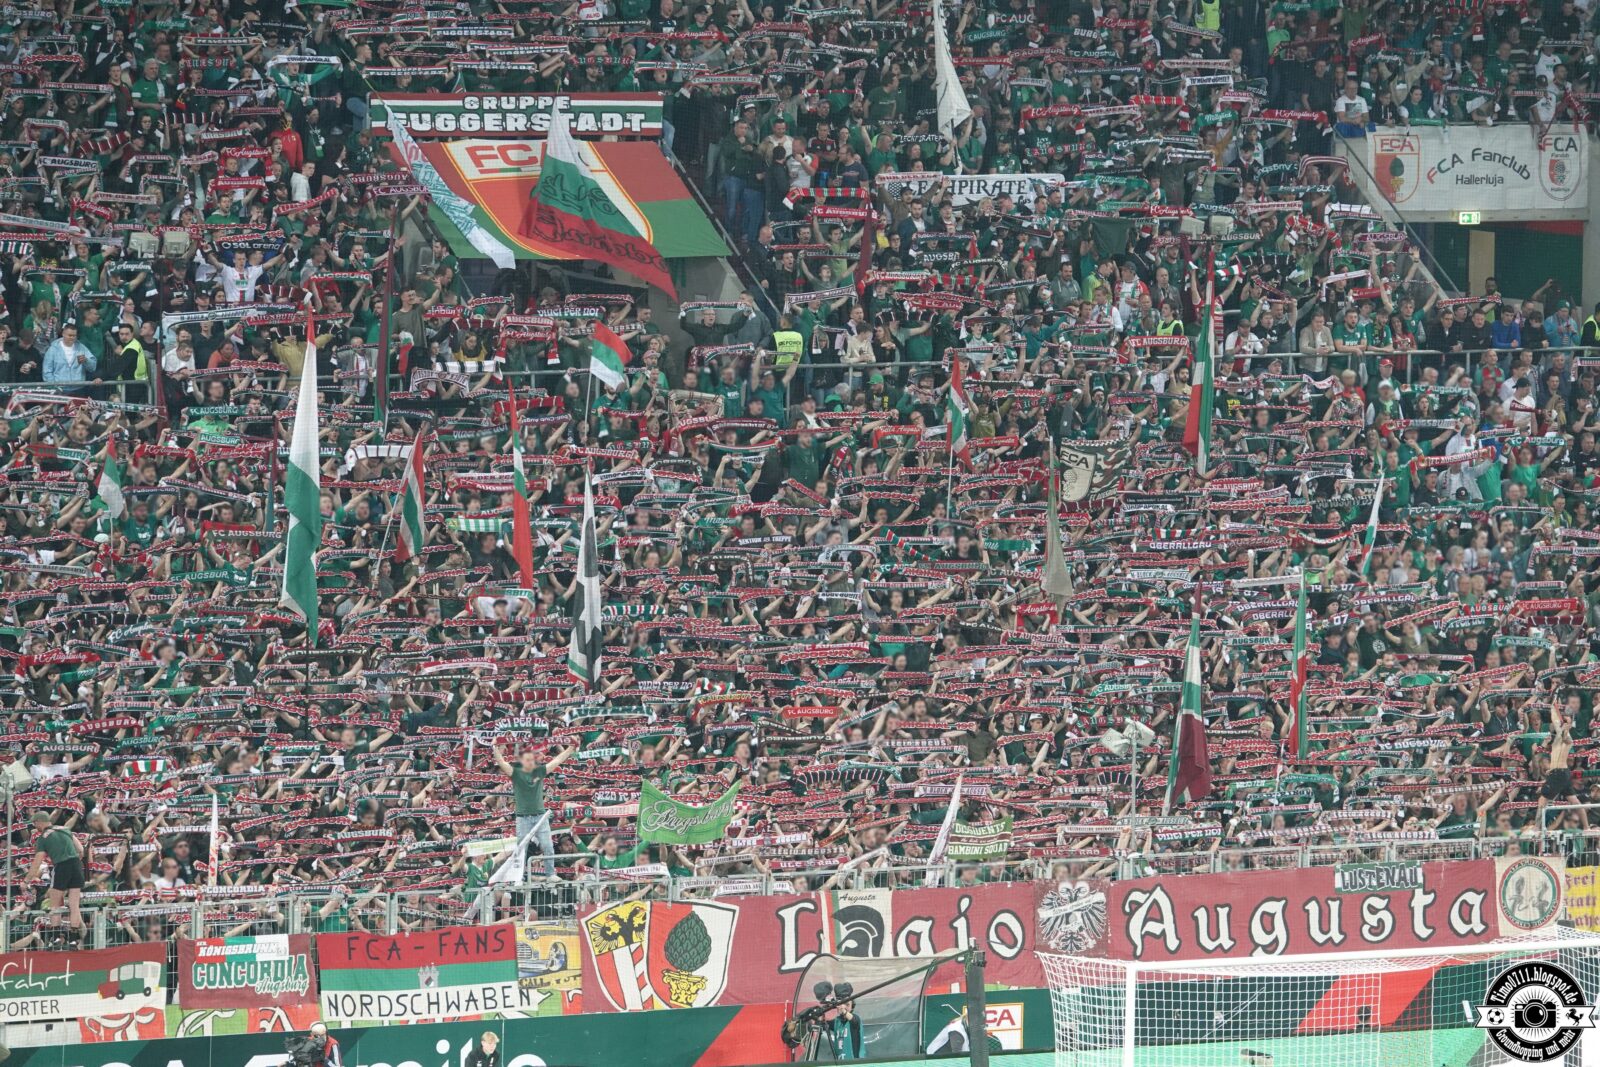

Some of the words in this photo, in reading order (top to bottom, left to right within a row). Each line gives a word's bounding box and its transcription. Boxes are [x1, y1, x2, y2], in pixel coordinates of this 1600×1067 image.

[995, 15, 1007, 23] FC
[463, 95, 571, 110] GRUPPE
[1381, 139, 1414, 151] FCA
[466, 143, 547, 168] FC
[51, 159, 96, 168] AUGSBURG
[1427, 153, 1464, 184] FCA
[1471, 148, 1531, 180] Fanclub
[1455, 174, 1504, 185] Hallerluja
[1130, 338, 1141, 346] FC
[1142, 338, 1188, 346] AUGSBURG
[1428, 384, 1471, 394] Augsburg
[200, 406, 238, 414] AUGSBURG
[1526, 436, 1564, 446] Augsburg
[1060, 450, 1089, 468] FCA
[227, 530, 282, 538] AUGSBURG
[186, 571, 228, 580] AUGSBUR
[1333, 614, 1348, 625] 07
[579, 749, 616, 759] MEISTER
[640, 796, 734, 838] Augsburg
[99, 844, 157, 854] CONRDIA
[948, 846, 983, 854] BAMBINI
[1341, 864, 1418, 892] LUSTENAU
[839, 893, 876, 904] Augusta
[1122, 883, 1488, 958] Augusta
[347, 936, 401, 961] FCA
[438, 929, 508, 956] FANS
[193, 954, 308, 989] CONCORDIA
[256, 976, 309, 998] Augsburg
[326, 985, 531, 1017] NORDSCHWABEN
[984, 1008, 1016, 1026] CA
